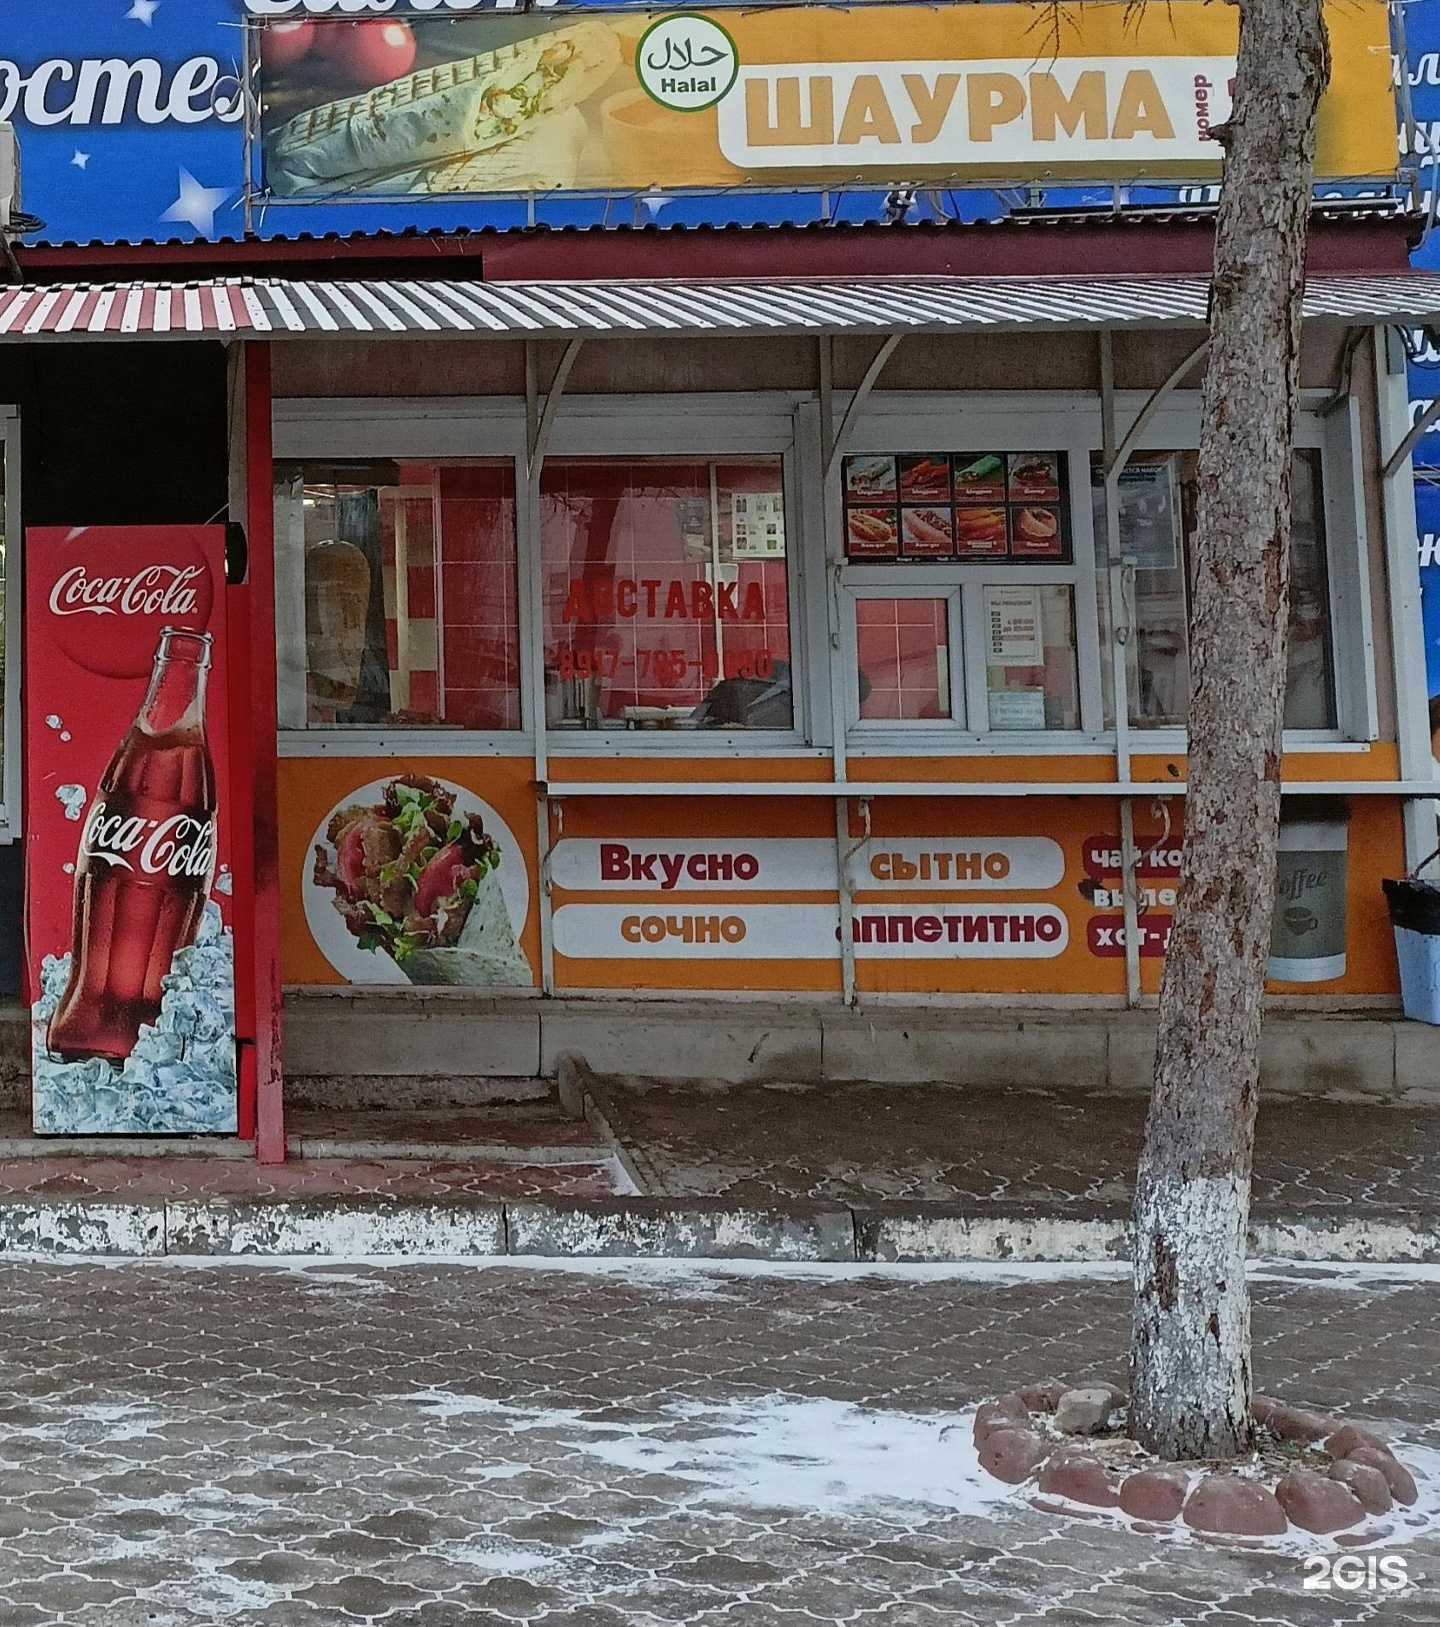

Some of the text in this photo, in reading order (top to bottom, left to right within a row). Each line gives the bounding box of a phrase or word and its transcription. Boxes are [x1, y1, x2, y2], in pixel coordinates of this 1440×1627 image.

[647, 37, 729, 71] حلال
[661, 77, 717, 93] Halal
[745, 69, 1175, 147] ШАУРМА
[50, 565, 205, 616] Coca-Cola
[600, 844, 759, 890] Вкусно
[870, 852, 1010, 881] сытно
[620, 914, 747, 944] сочно
